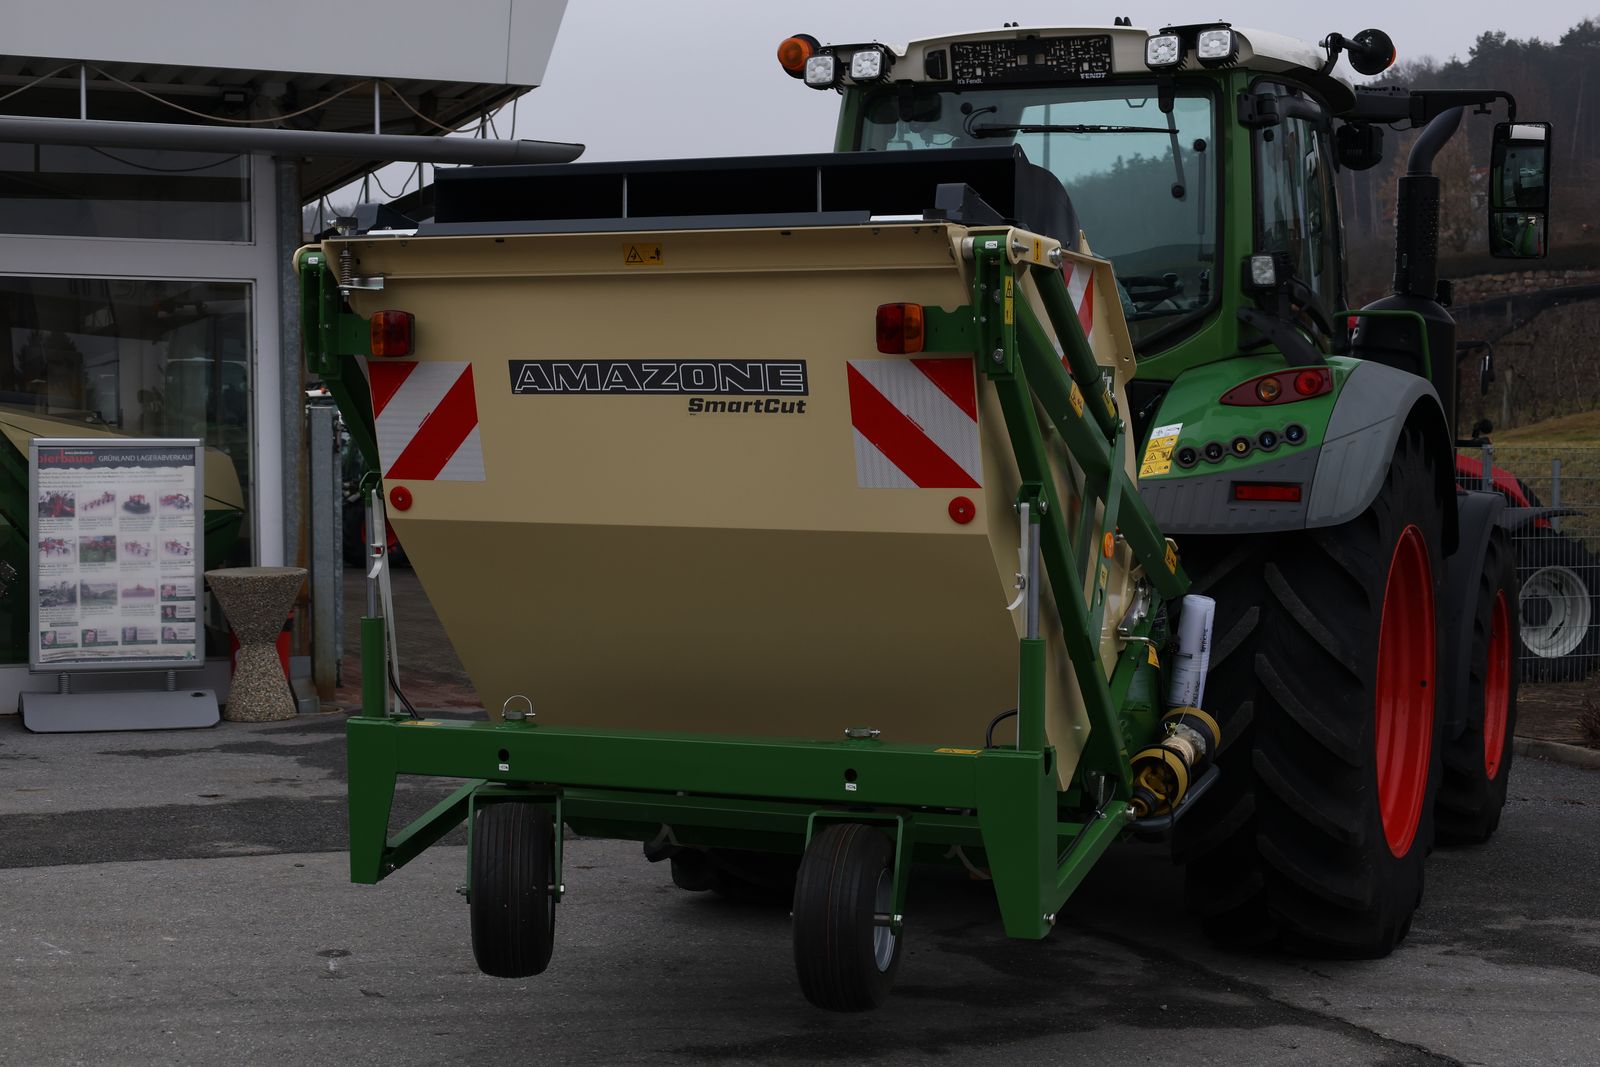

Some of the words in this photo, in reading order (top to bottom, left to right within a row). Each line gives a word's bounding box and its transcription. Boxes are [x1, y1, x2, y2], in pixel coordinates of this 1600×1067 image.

[1079, 71, 1107, 80] FENDT
[513, 363, 805, 393] AMAZONE
[688, 397, 807, 414] SmartCut
[98, 453, 136, 462] GRÜNLAND
[136, 453, 193, 462] LAGERABVERKAUF
